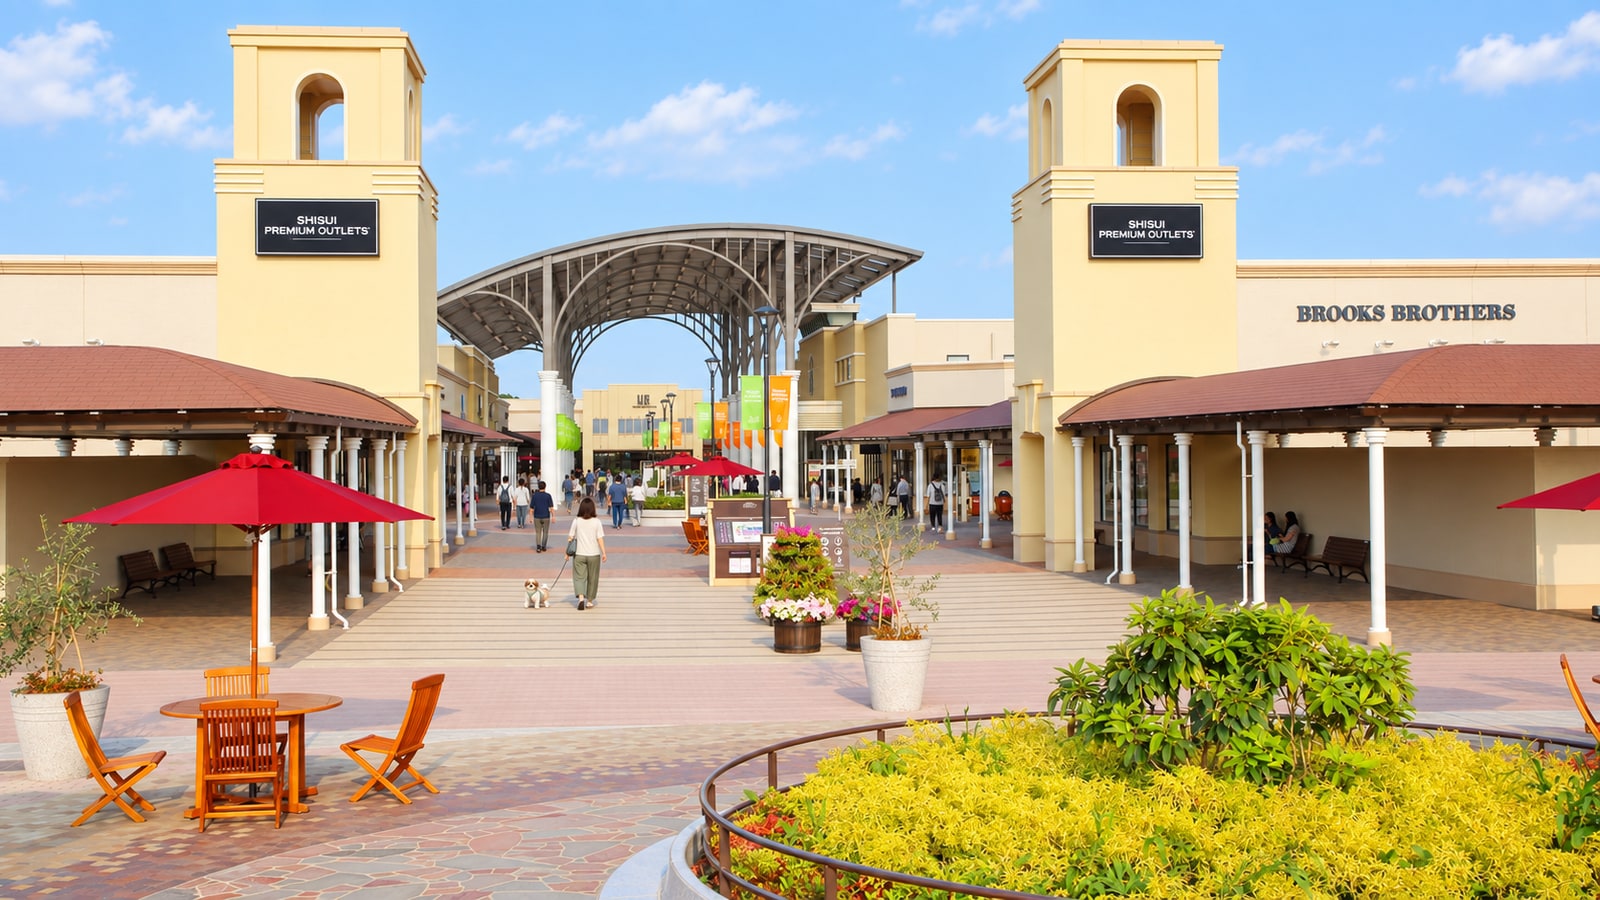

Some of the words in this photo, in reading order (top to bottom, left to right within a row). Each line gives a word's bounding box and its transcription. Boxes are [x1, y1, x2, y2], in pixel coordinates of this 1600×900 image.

[296, 215, 337, 225] SHISUI
[1128, 220, 1166, 229] SHISUI
[264, 226, 315, 235] PREMIUM
[318, 226, 369, 235] OUTLETS
[1098, 230, 1146, 239] PREMIUM
[1147, 230, 1195, 239] OUTLETS
[1296, 304, 1386, 322] BROOKS
[1391, 303, 1516, 321] BROTHERS
